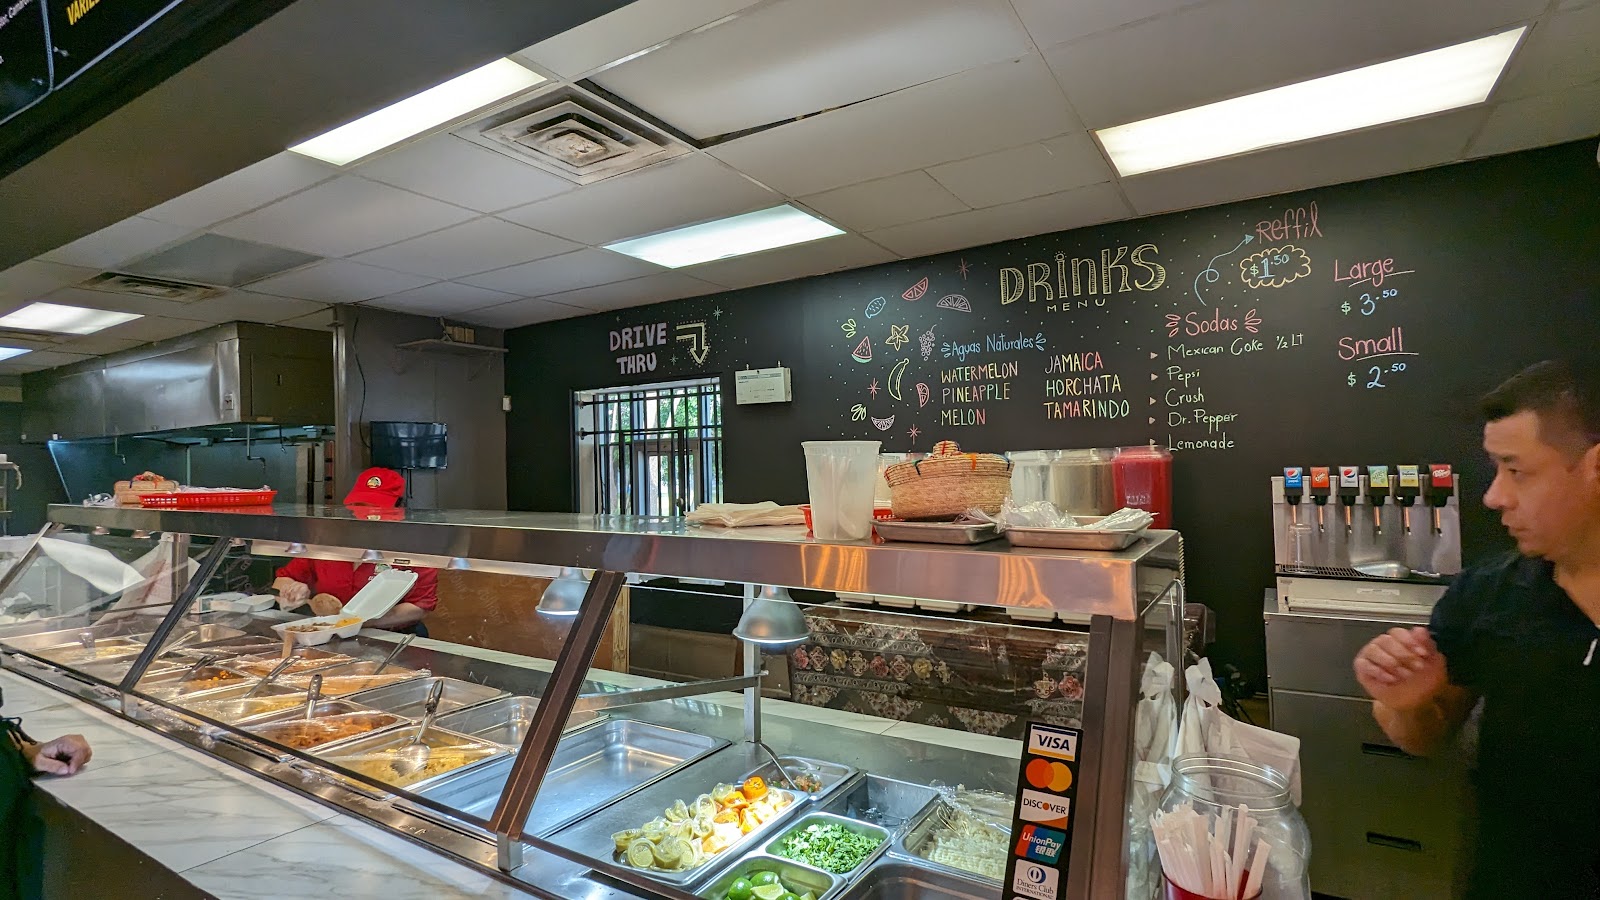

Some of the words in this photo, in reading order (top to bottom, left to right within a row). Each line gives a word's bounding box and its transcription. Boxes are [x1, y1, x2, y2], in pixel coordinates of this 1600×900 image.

[1334, 257, 1395, 287] Large
[1046, 298, 1106, 313] MENU
[1184, 307, 1238, 336] Sodas
[609, 322, 667, 352] DRIVE
[951, 340, 981, 362] Aguas
[986, 332, 1034, 352] Naturales
[1338, 326, 1403, 361] Small
[1044, 351, 1104, 374] JAMAICA
[1167, 343, 1224, 360] Mexican
[616, 352, 658, 375] THRU
[941, 361, 1019, 384] WATERMELON
[1046, 374, 1122, 398] HORCHATA
[1166, 365, 1201, 388] Pepsi
[942, 382, 1011, 404] PINEAPPLE
[1165, 387, 1205, 407] Crush
[941, 408, 986, 426] MELON
[1043, 398, 1130, 419] TAMARINDO
[1167, 411, 1191, 427] Dr.
[1193, 408, 1239, 434] Pepper
[1165, 432, 1235, 451] Lemonade
[1036, 733, 1070, 752] VISA
[1023, 797, 1067, 815] DISCOVER
[1022, 831, 1061, 851] UnionPay
[1016, 878, 1038, 891] Diners
[1038, 884, 1054, 895] Club
